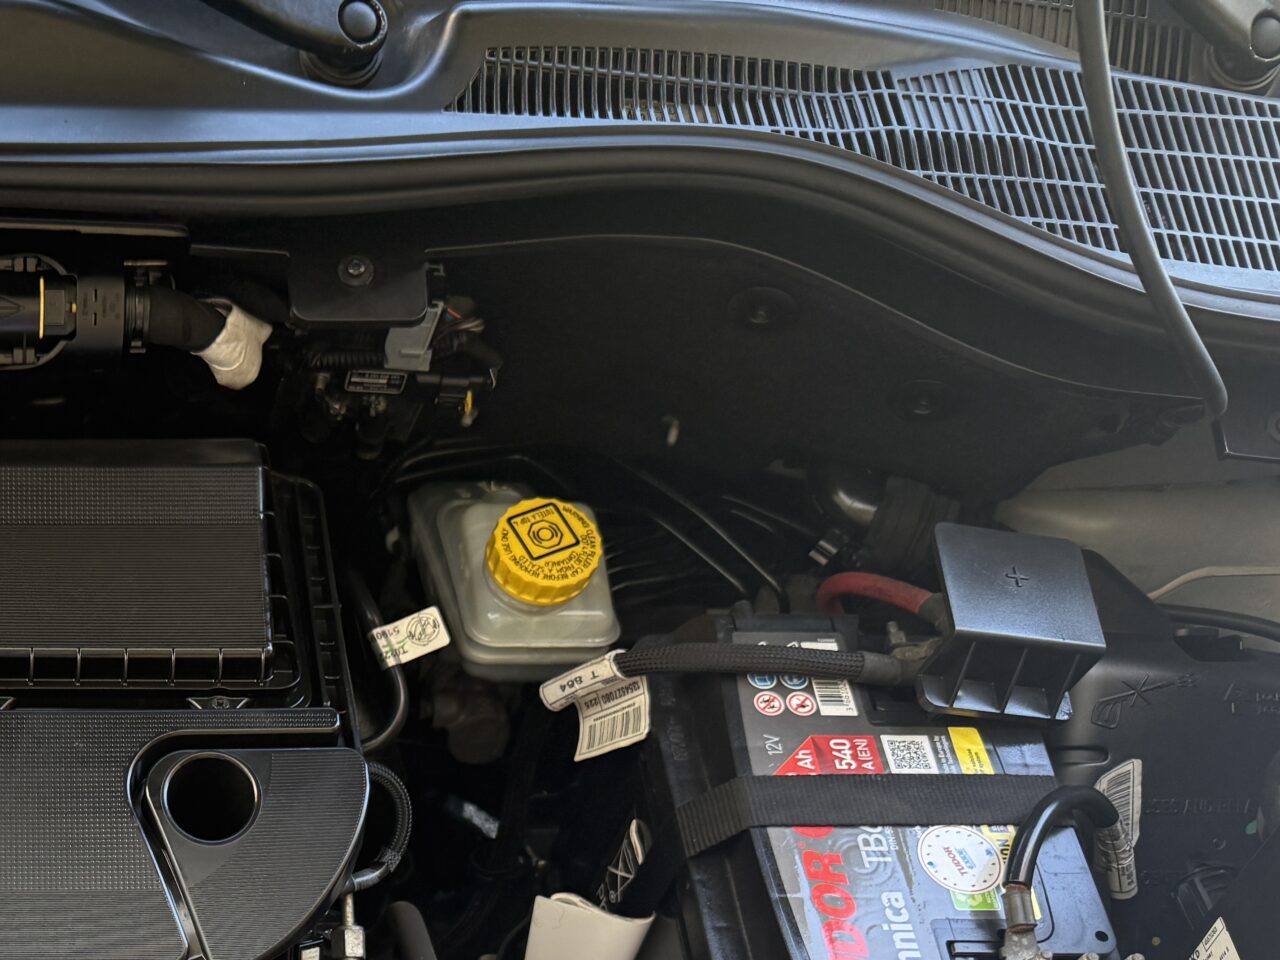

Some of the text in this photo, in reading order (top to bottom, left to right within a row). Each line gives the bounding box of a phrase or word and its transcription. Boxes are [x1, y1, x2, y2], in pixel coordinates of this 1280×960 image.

[532, 508, 555, 520] TUTELA
[586, 529, 596, 550] CLEAN
[502, 543, 512, 558] USE
[519, 556, 545, 573] SEALED
[544, 551, 577, 567] CONTAINER
[574, 552, 588, 566] FLUID
[583, 550, 595, 568] FILLER
[543, 573, 569, 581] BEFORE
[556, 565, 574, 573] FROM
[571, 568, 583, 578] CAP
[588, 669, 599, 679] T
[558, 674, 584, 692] 864
[763, 734, 784, 756] 12V
[795, 749, 816, 769] Ah
[829, 739, 857, 770] 540
[943, 846, 969, 877] TUDOR
